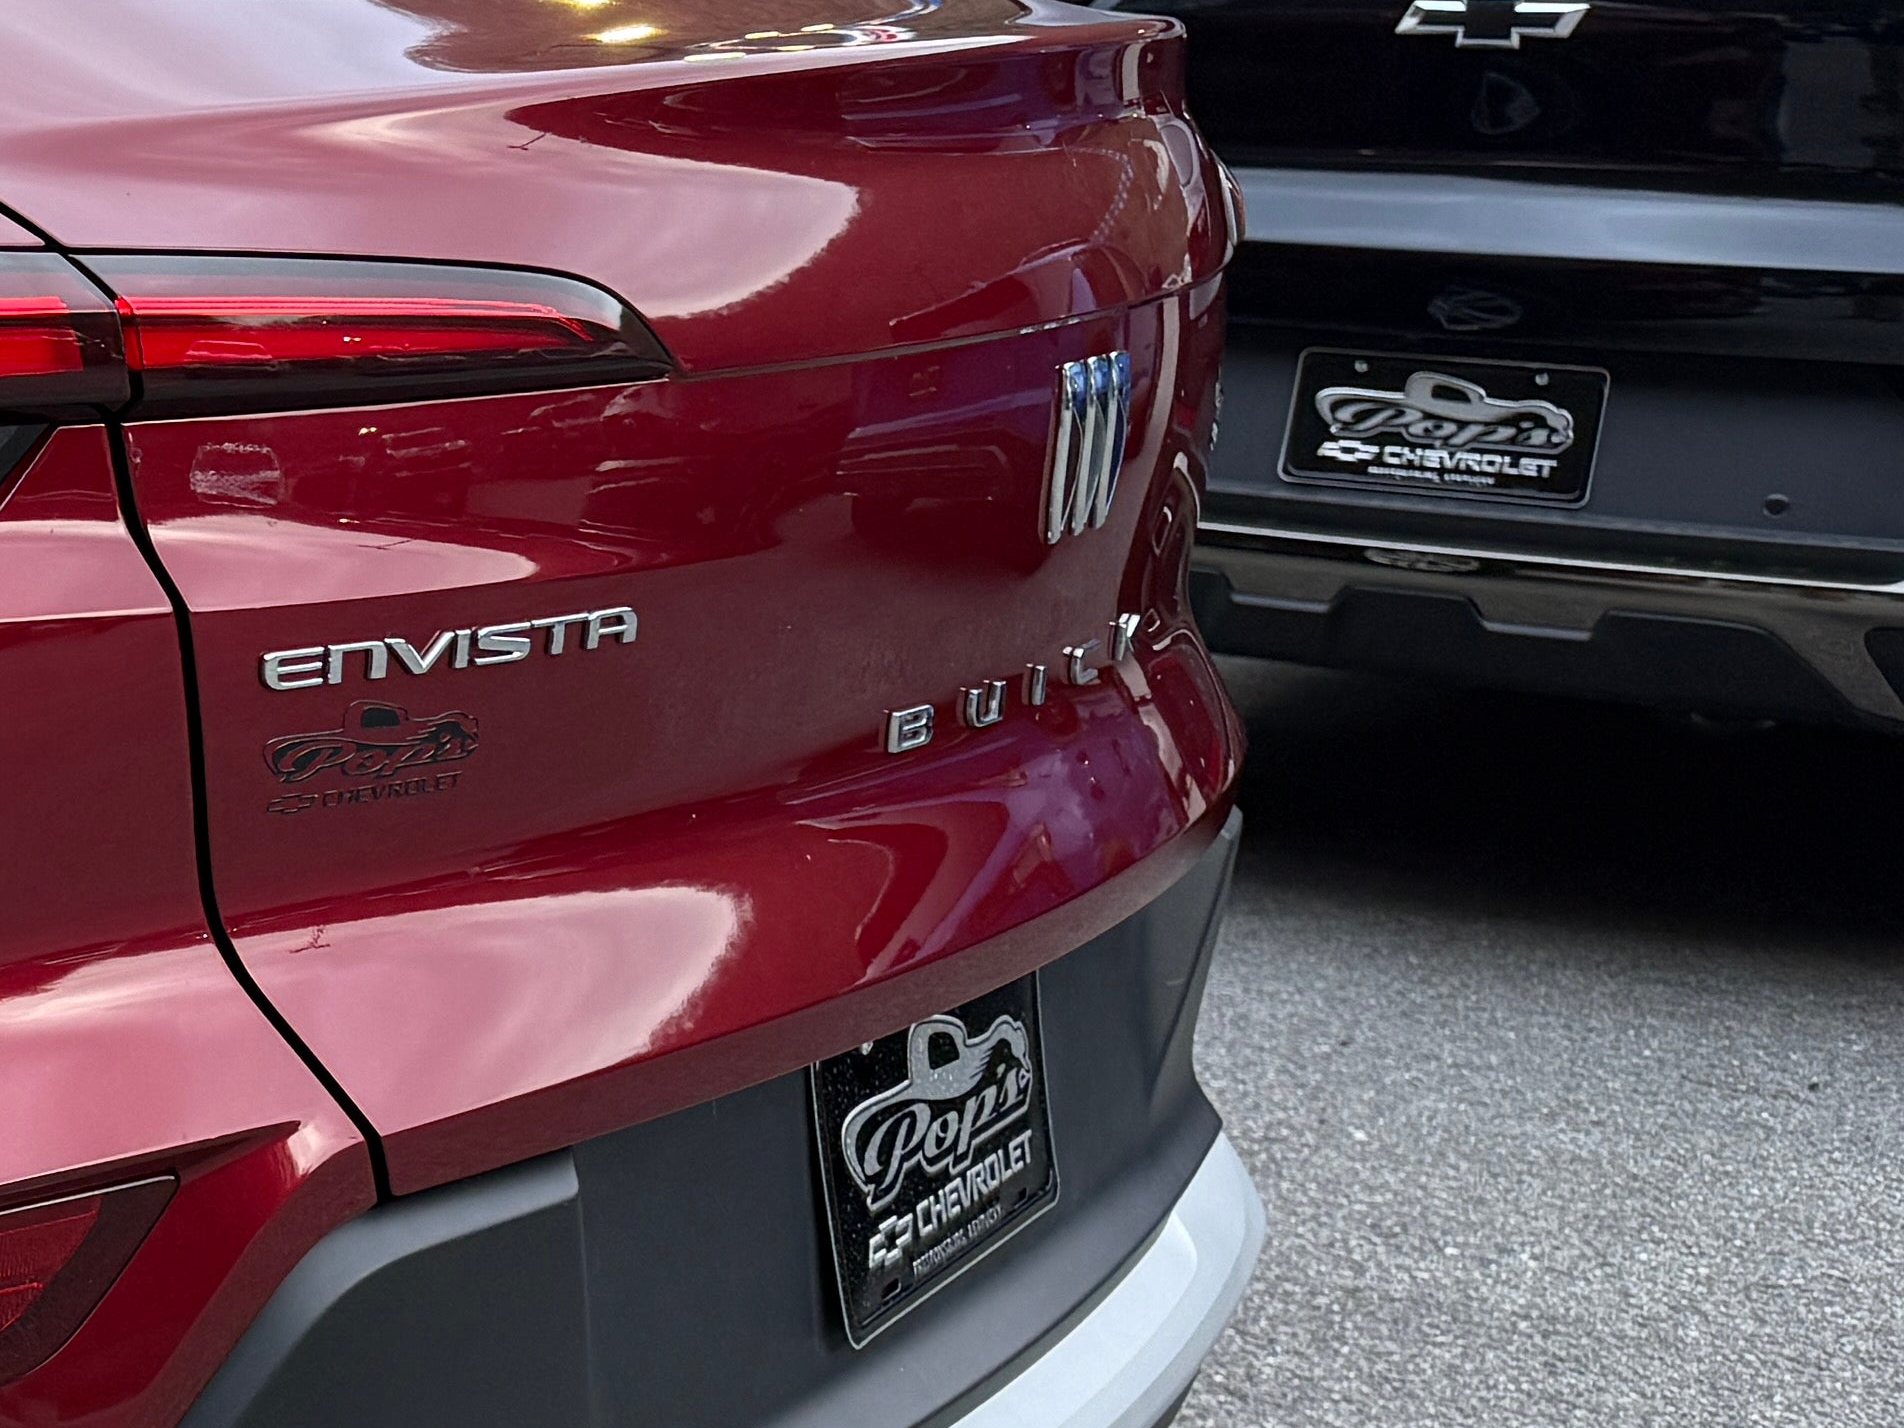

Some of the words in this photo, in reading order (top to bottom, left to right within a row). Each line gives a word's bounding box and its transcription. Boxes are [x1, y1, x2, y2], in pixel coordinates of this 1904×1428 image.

[1382, 445, 1558, 478] CHEVROLET
[261, 606, 638, 691] ENVISTA
[886, 613, 1141, 754] BUICK
[322, 771, 463, 810] CHEVROLET
[917, 1129, 1033, 1234] CHEVROLET
